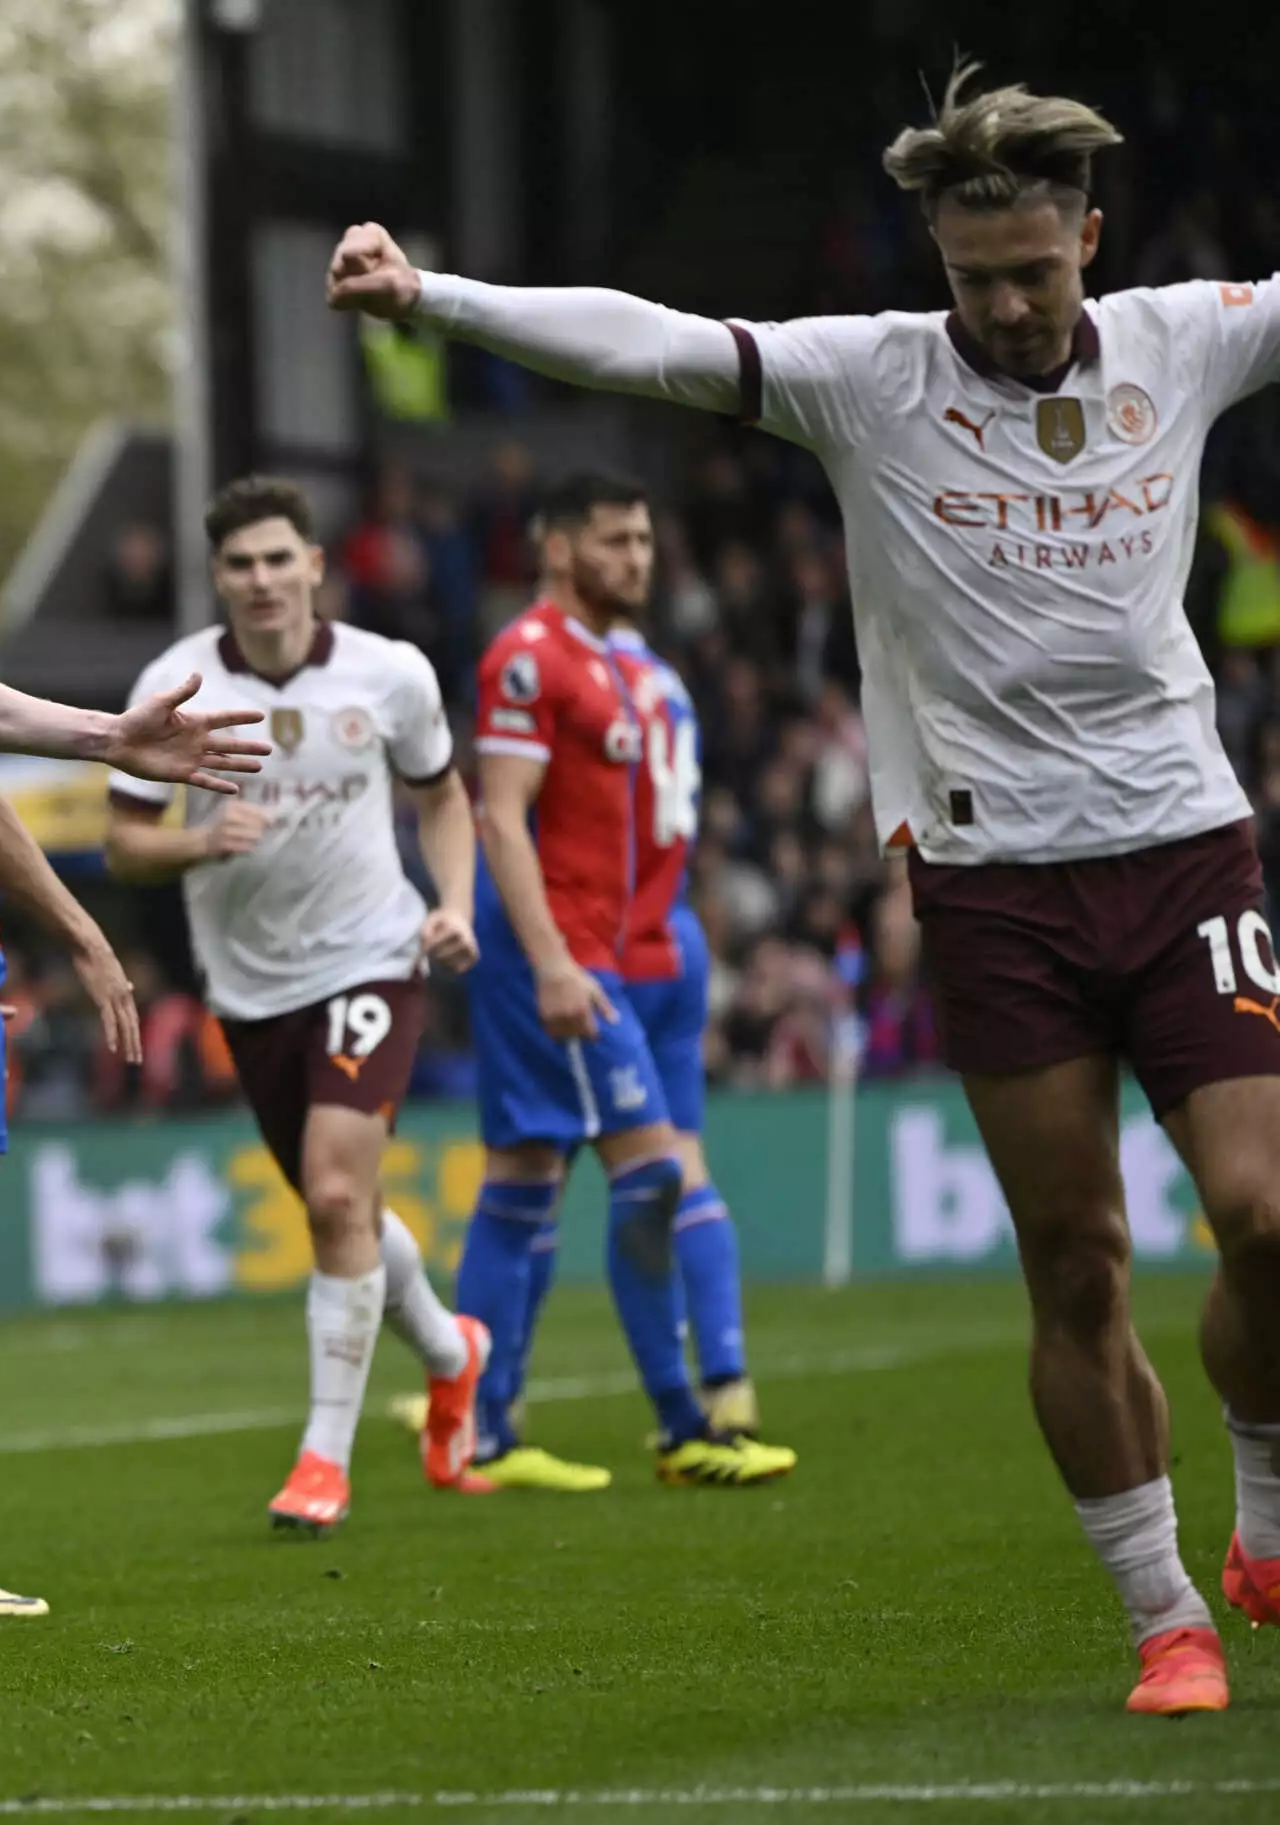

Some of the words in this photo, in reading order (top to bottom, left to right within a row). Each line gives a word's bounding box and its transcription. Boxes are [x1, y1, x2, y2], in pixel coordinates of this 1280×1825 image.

[933, 472, 1175, 531] ETIHAD
[989, 531, 1154, 570] AIRWAYS
[1196, 909, 1280, 995] 10
[325, 992, 392, 1057] 19
